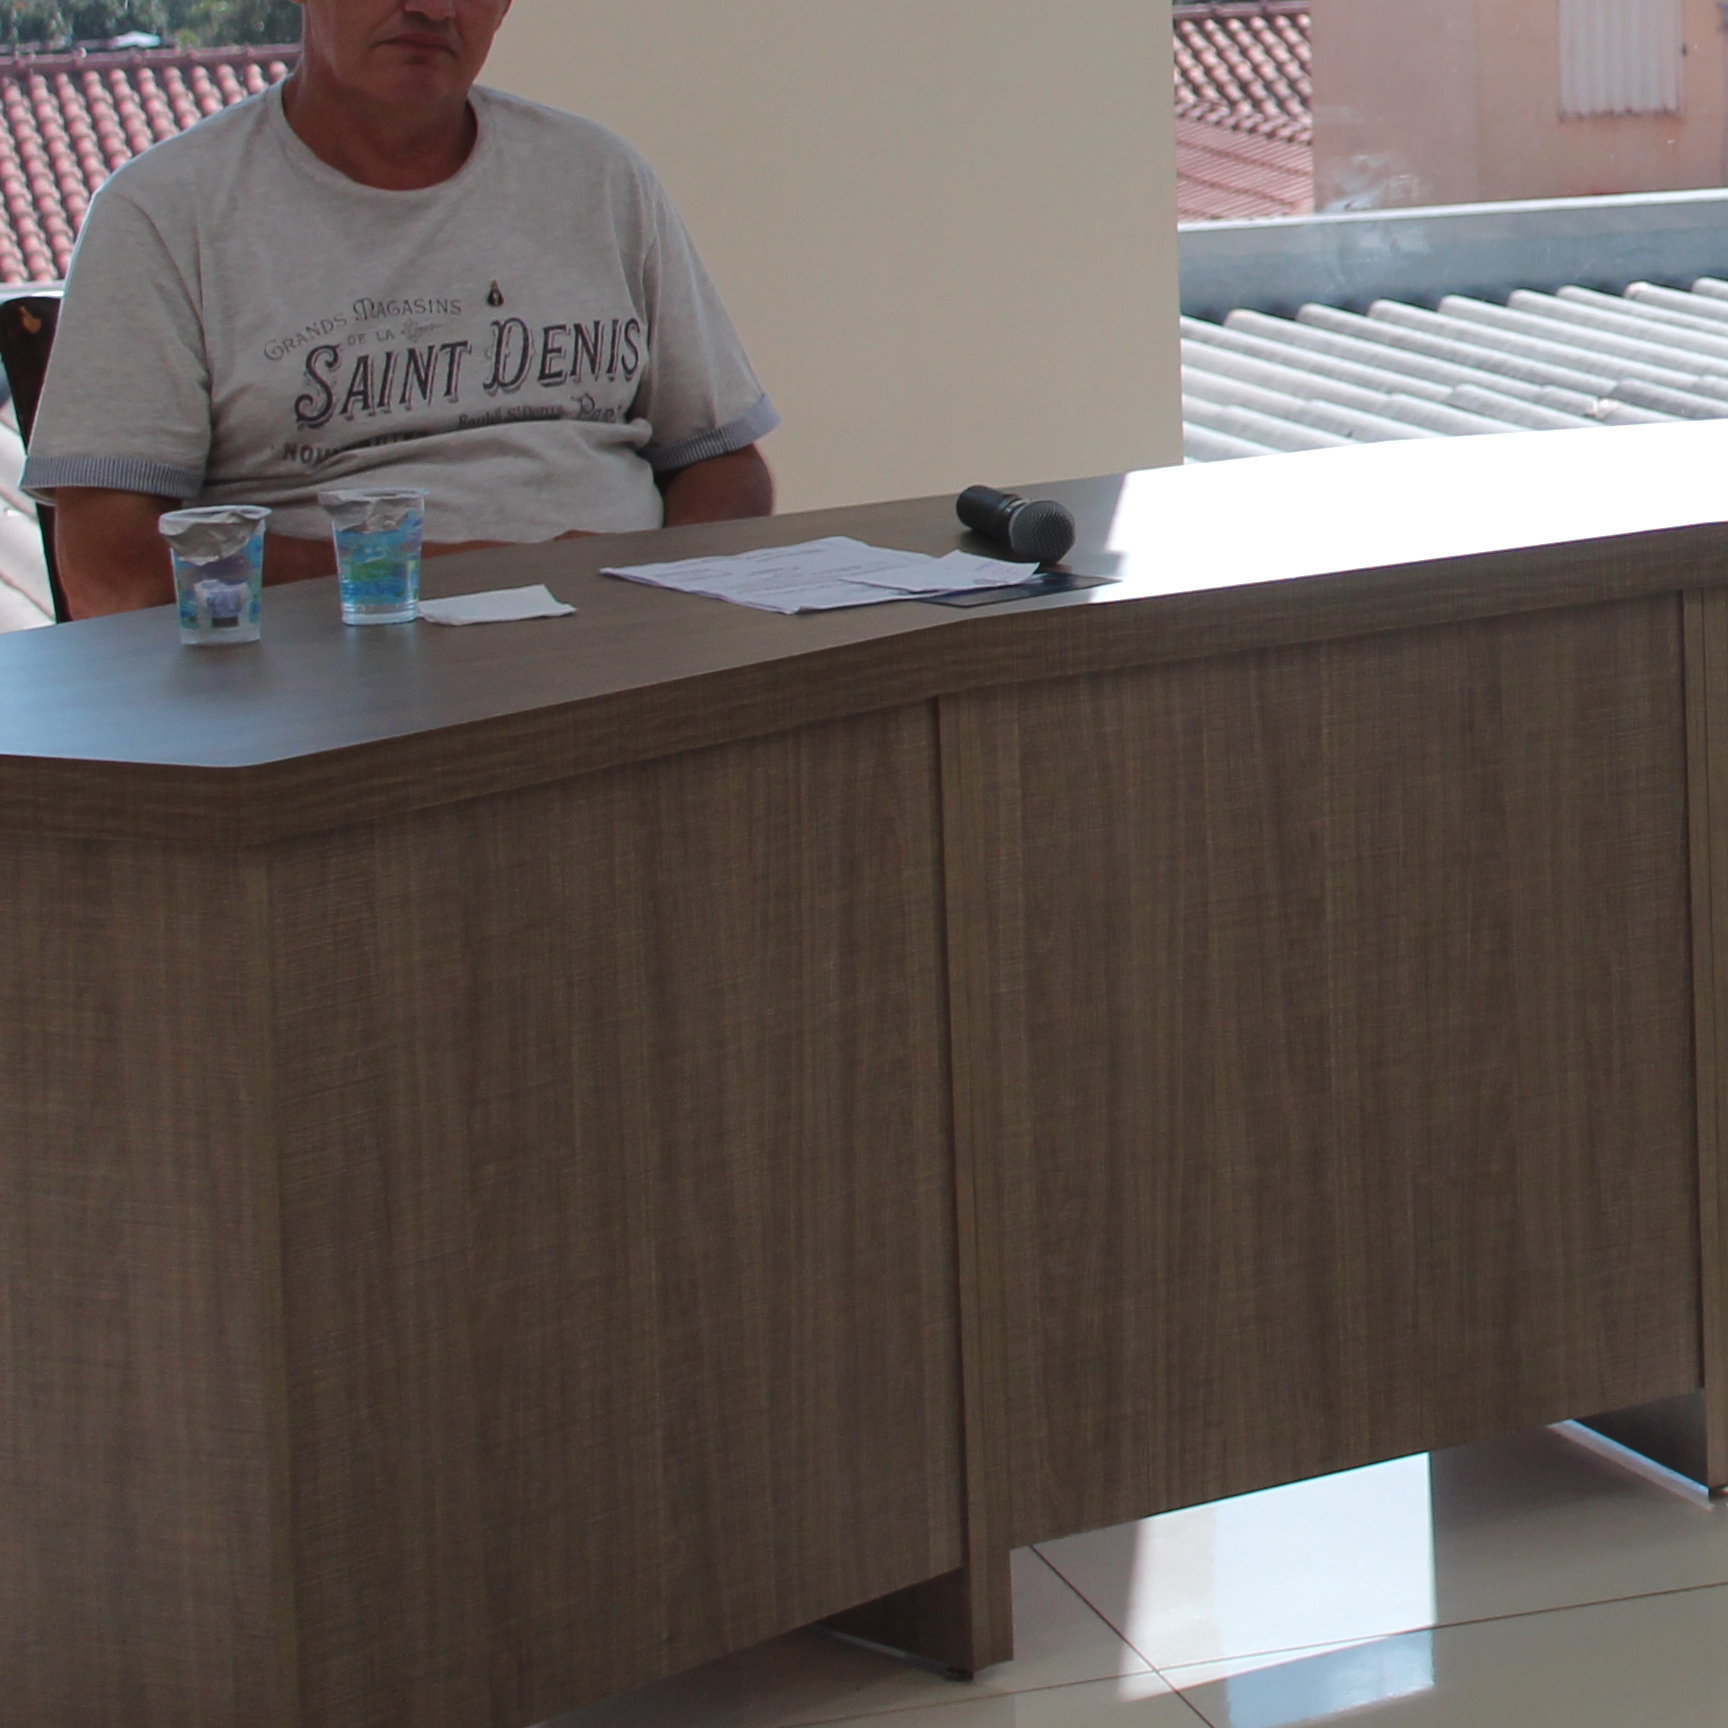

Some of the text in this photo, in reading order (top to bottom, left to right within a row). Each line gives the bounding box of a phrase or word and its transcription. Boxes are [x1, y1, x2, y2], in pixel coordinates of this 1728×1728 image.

[348, 329, 395, 346] DE LA
[294, 317, 642, 429] SAINT DENIS
